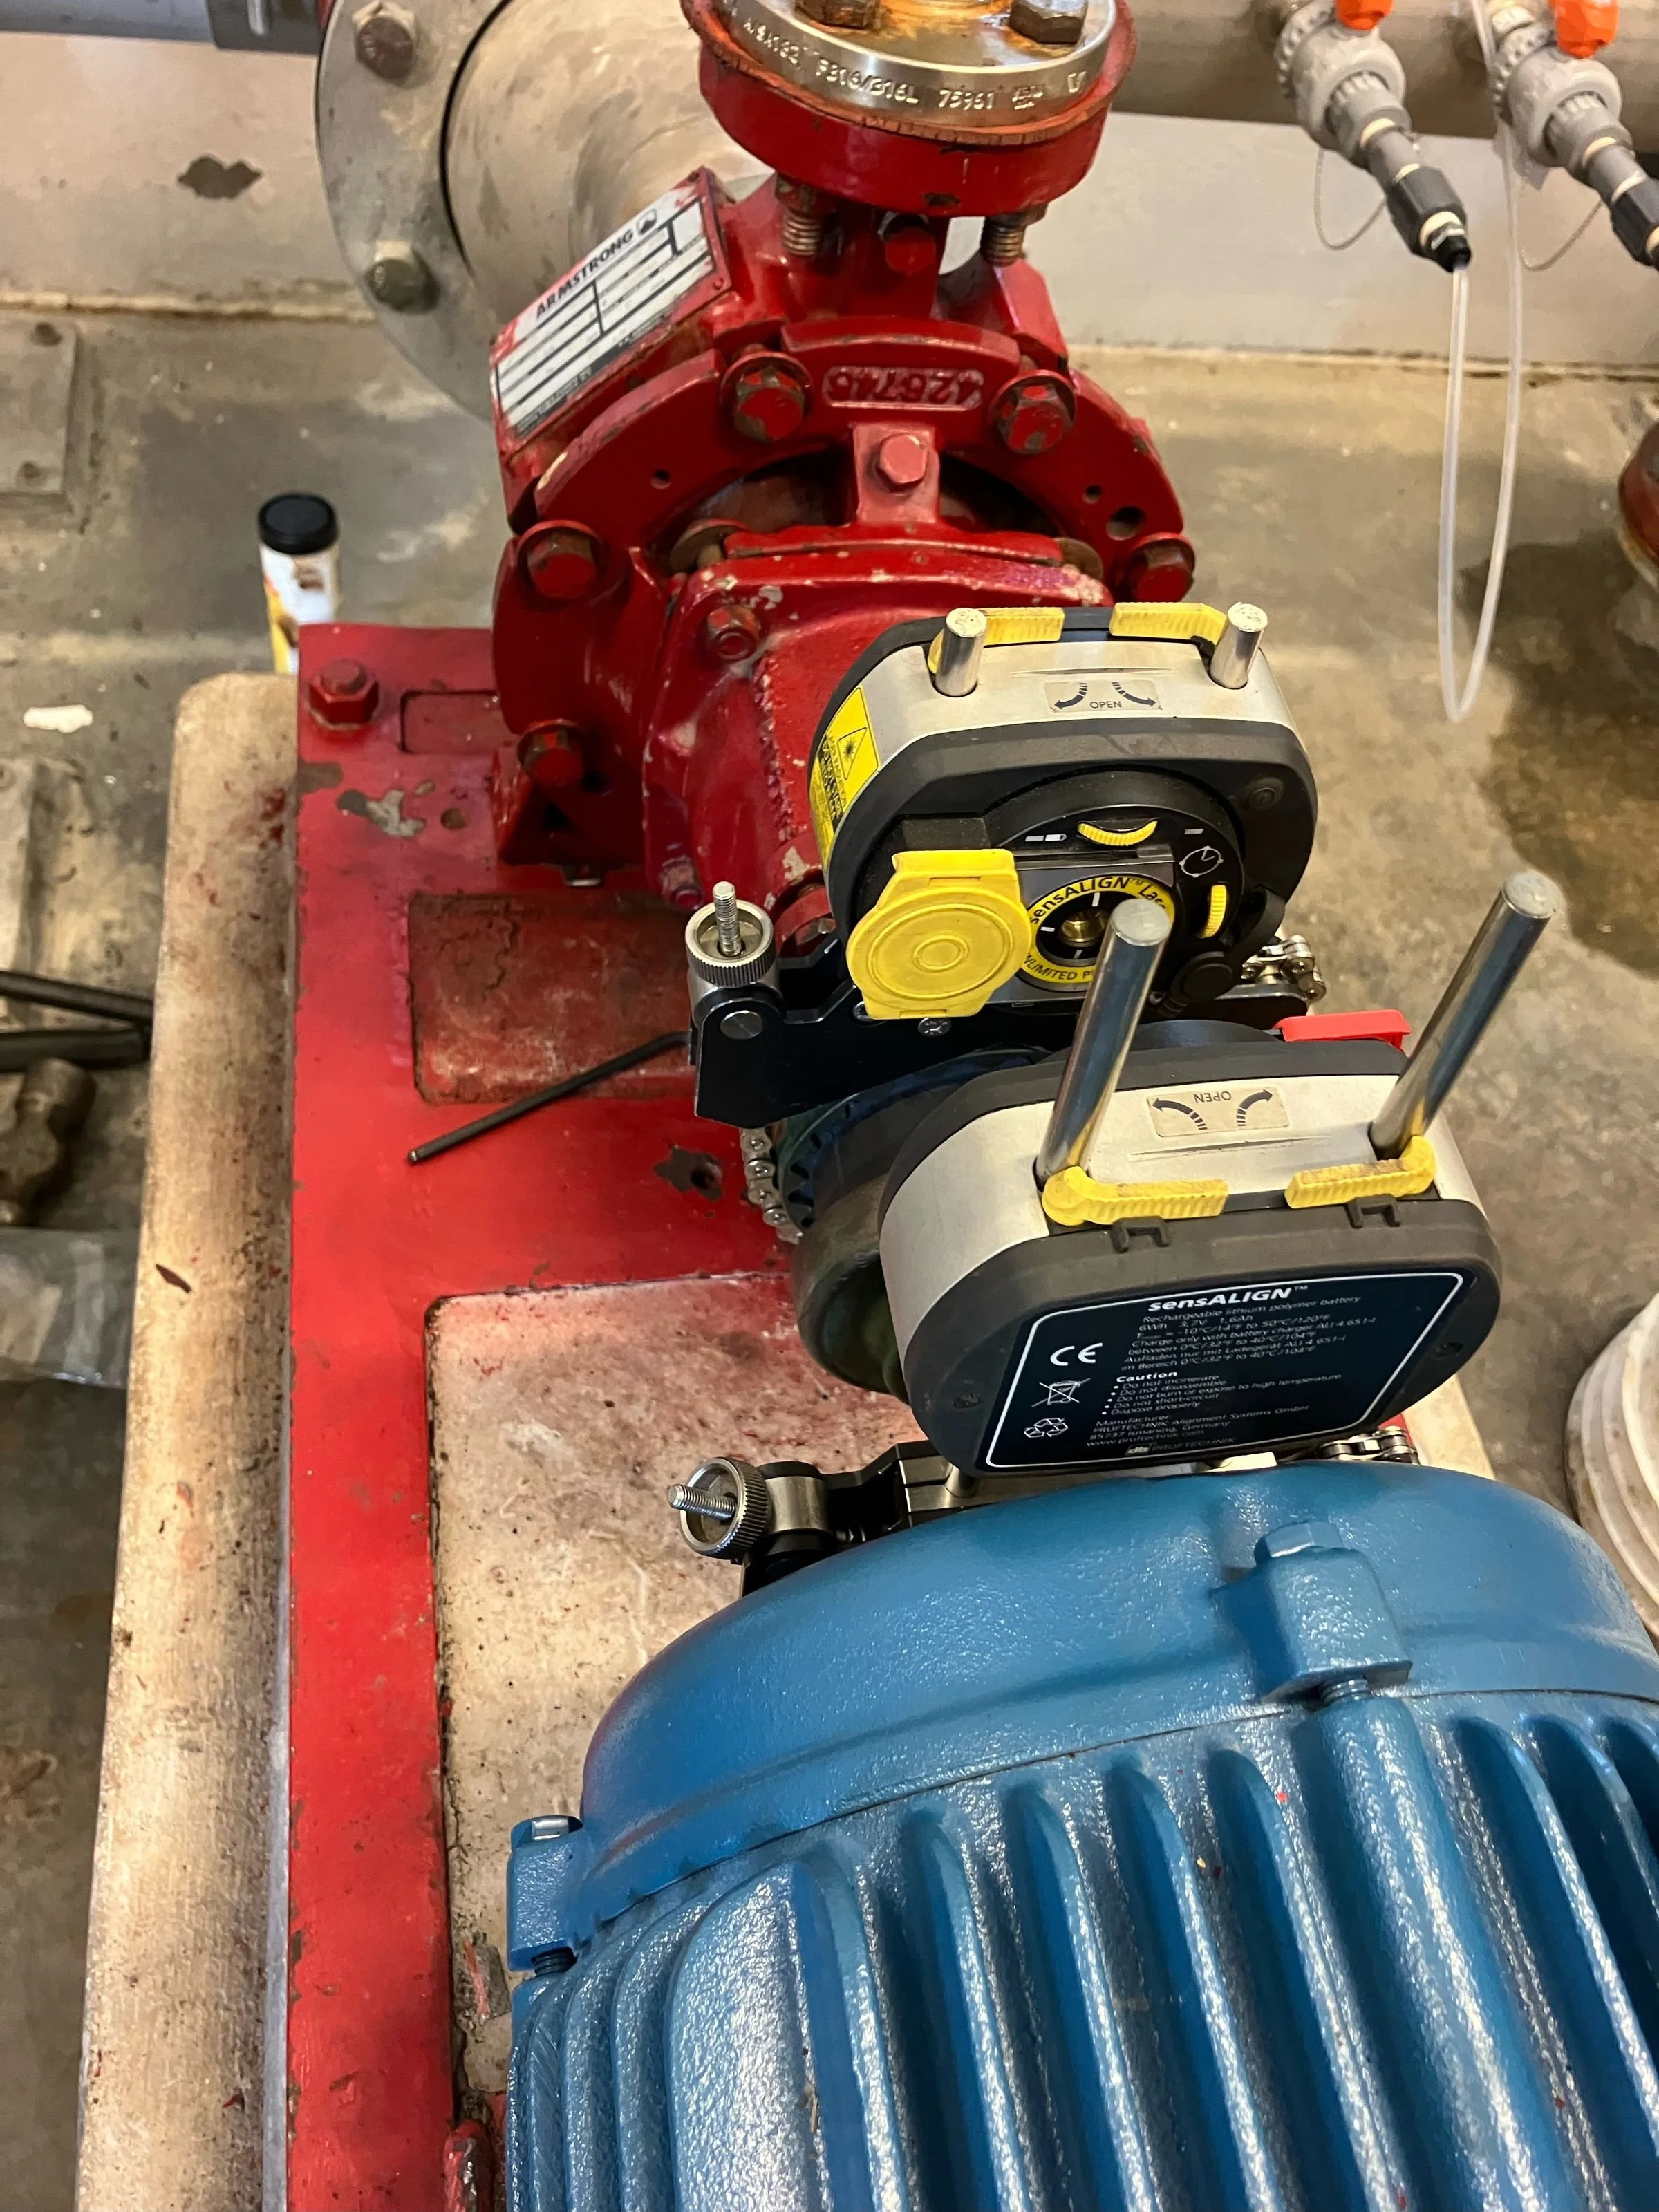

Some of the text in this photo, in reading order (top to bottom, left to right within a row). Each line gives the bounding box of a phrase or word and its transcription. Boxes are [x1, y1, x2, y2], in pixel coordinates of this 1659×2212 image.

[536, 229, 633, 318] ARMSTRONG
[1090, 701, 1122, 709] OPEN
[1194, 1091, 1231, 1103] OPEN
[1143, 1296, 1362, 1323] Rechargeable lithium polymer battery
[1132, 1338, 1174, 1348] Charge
[1175, 1335, 1200, 1344] only
[1203, 1332, 1227, 1340] with
[1230, 1329, 1268, 1340] battery
[1271, 1324, 1313, 1335] charger
[1128, 1346, 1177, 1356] between
[1116, 1371, 1177, 1382] Caution
[1165, 1374, 1219, 1385] incinerate
[1156, 1390, 1181, 1398] burn
[1198, 1385, 1236, 1395] expose
[1252, 1380, 1275, 1389] high
[1279, 1374, 1342, 1386] temperature
[1161, 1380, 1226, 1391] disassemble
[1155, 1392, 1219, 1405] short-circuit
[1111, 1401, 1201, 1416] Dispose properly
[1172, 1415, 1227, 1425] Alignment
[1230, 1409, 1271, 1419] Systems
[1275, 1405, 1309, 1415] GmbH
[1183, 1421, 1230, 1431] Germany
